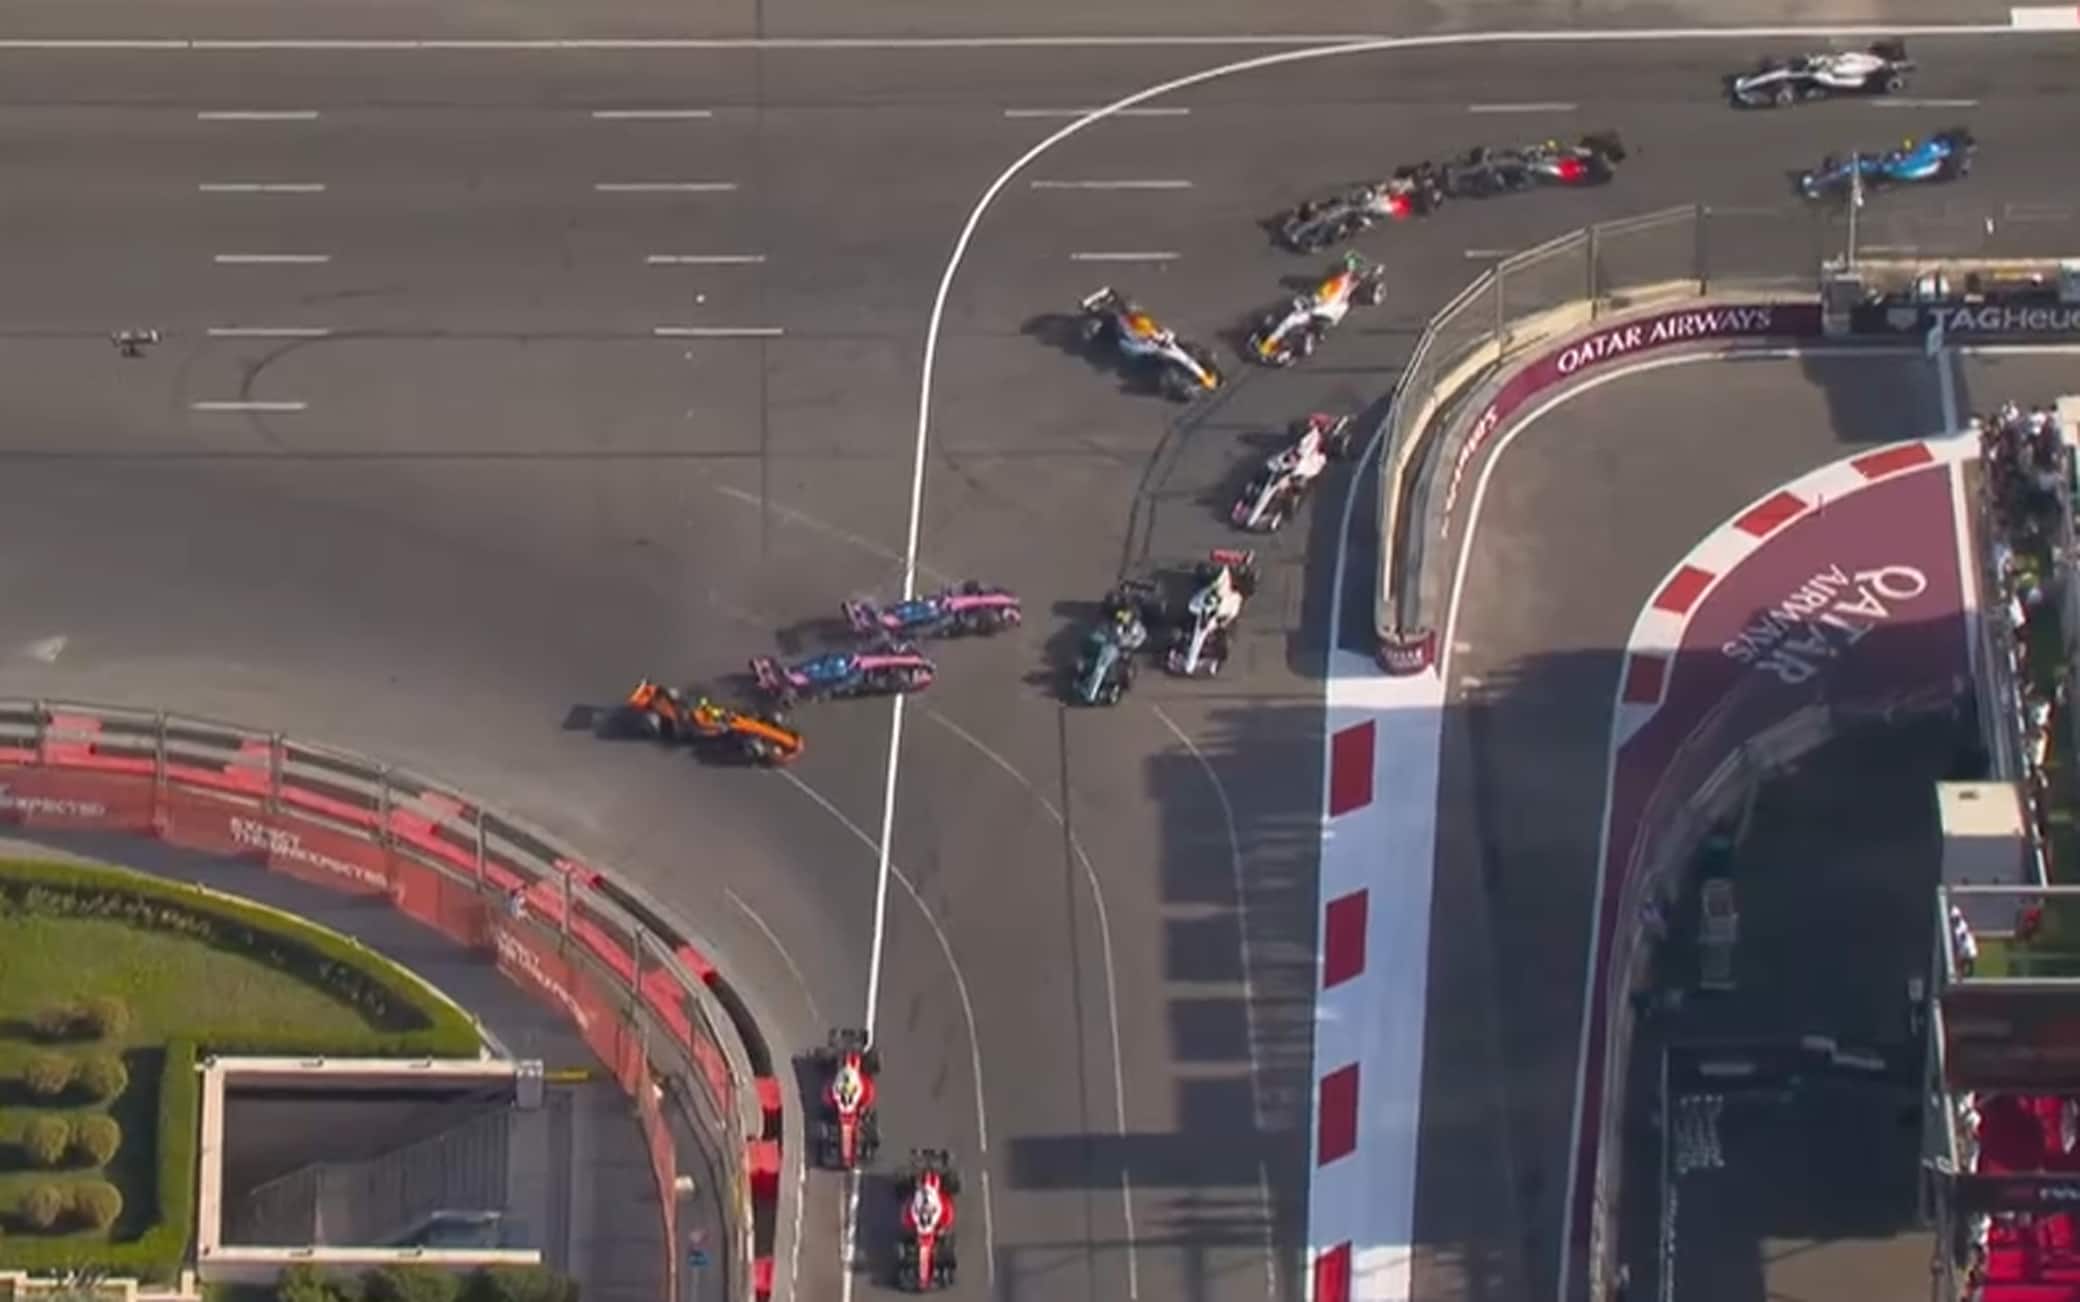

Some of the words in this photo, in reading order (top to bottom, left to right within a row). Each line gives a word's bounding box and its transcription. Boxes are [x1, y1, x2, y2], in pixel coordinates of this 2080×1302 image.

[1557, 325, 1642, 373] QATAR
[1650, 308, 1772, 344] AIRWAYS
[1721, 563, 1849, 663] AIRWAYS
[1755, 565, 1927, 684] QATAR
